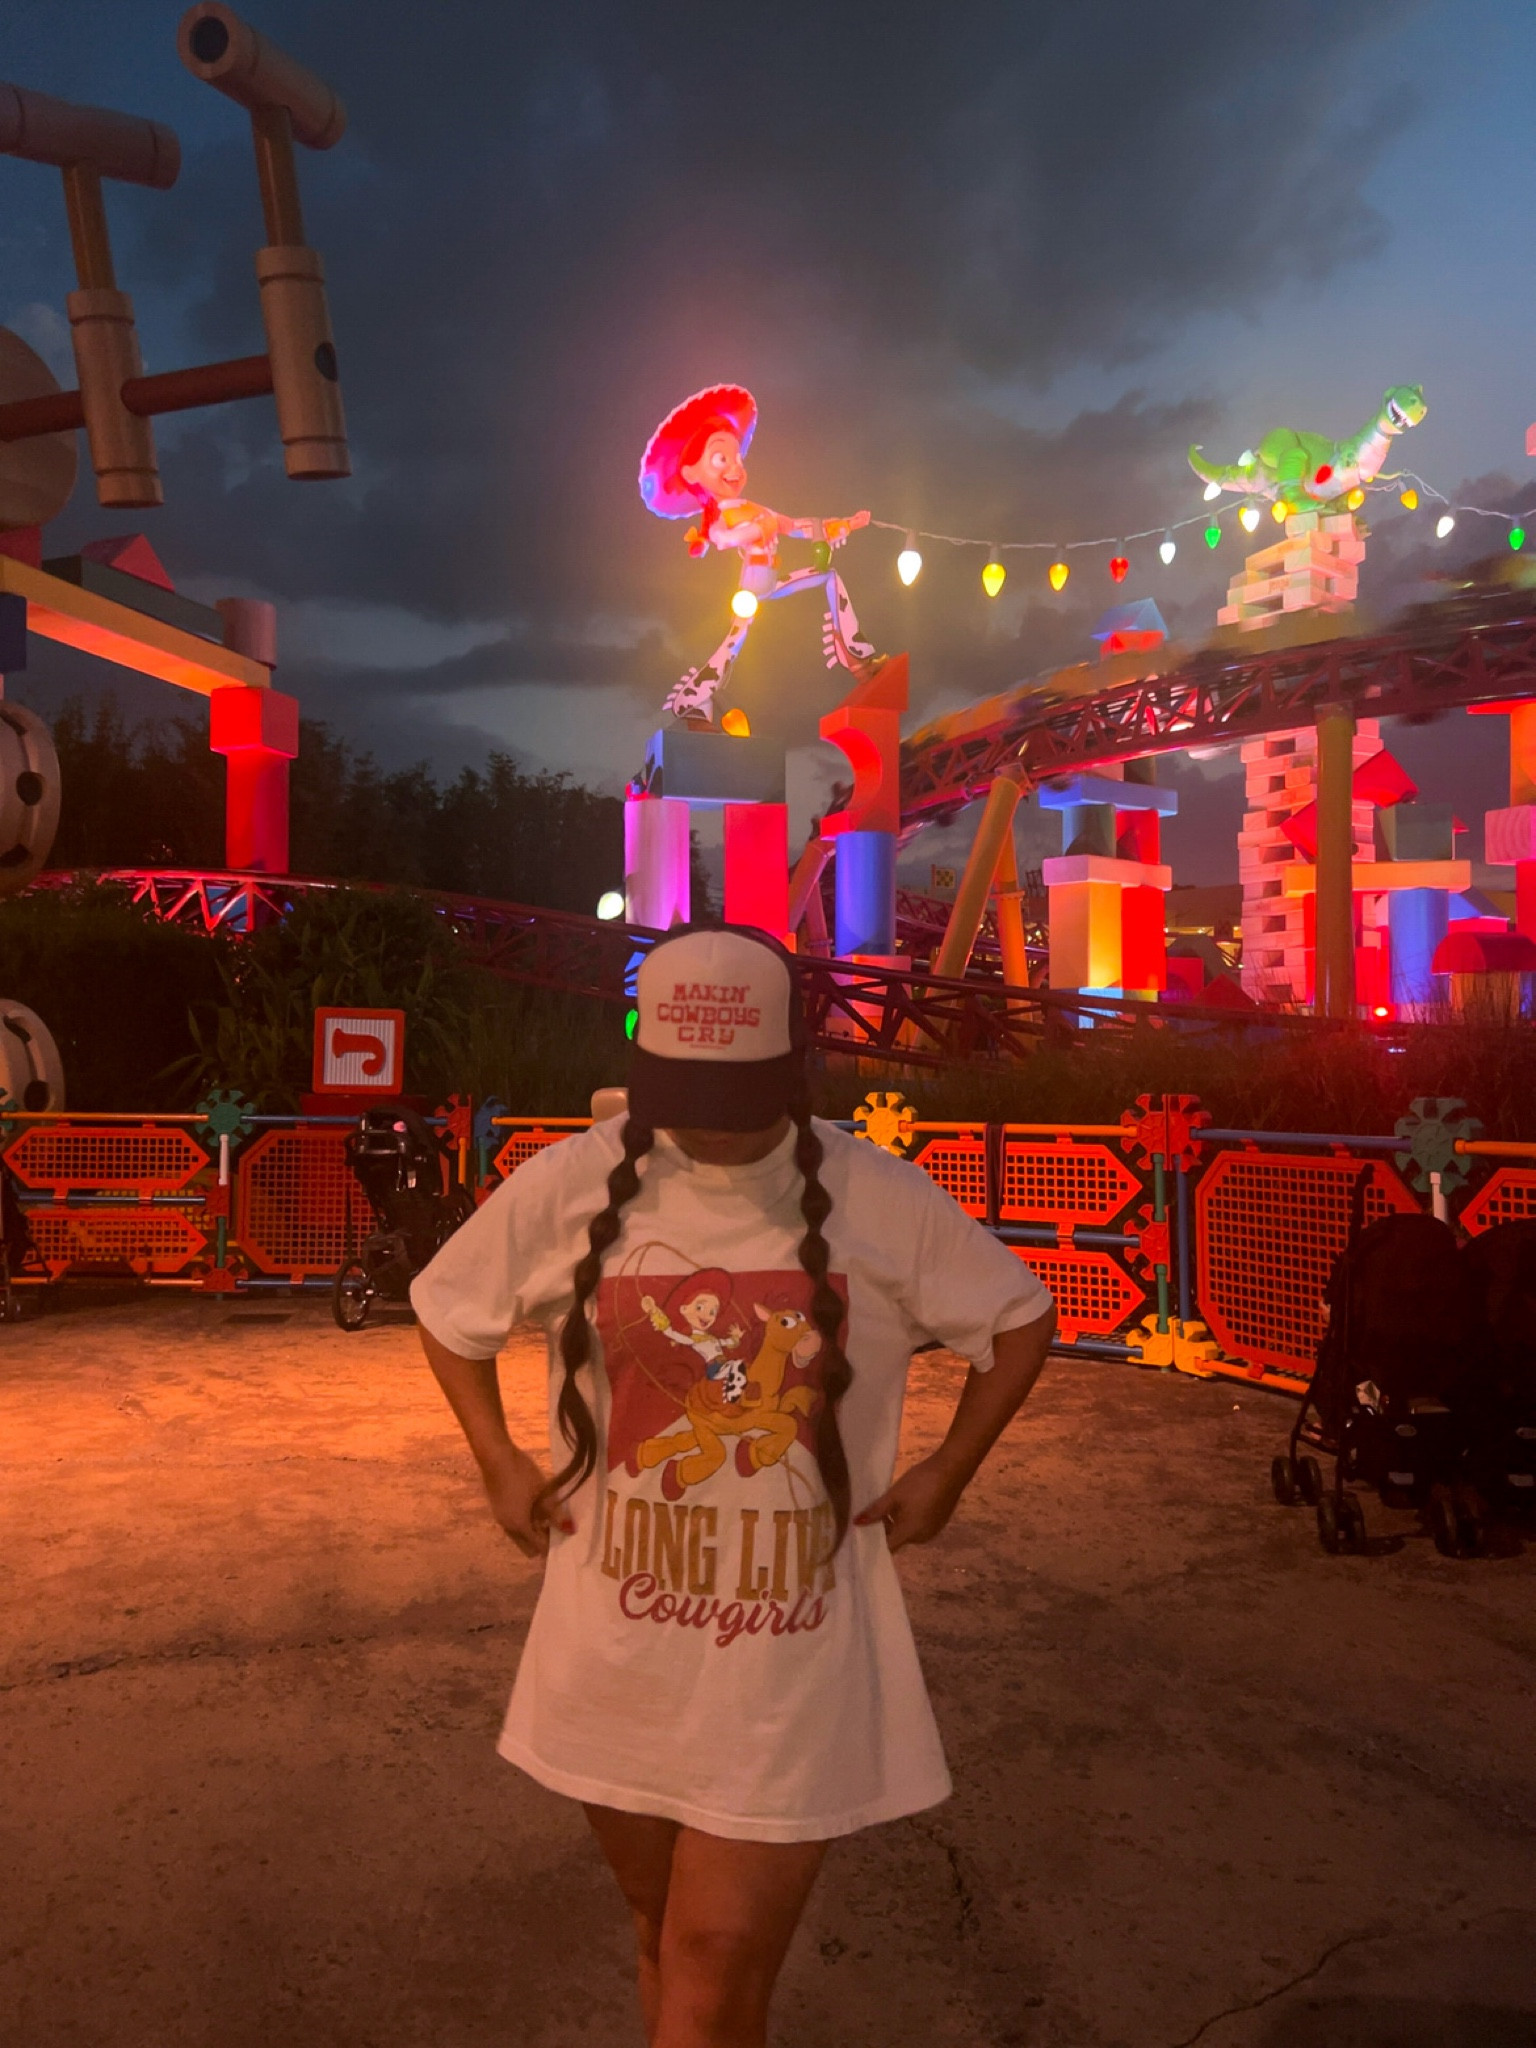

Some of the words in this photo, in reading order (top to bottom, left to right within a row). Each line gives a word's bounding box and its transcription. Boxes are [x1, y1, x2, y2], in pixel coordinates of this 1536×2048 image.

[657, 1003, 761, 1028] COWBOYS
[677, 1026, 735, 1045] CRY
[601, 1489, 718, 1595] LONG
[619, 1572, 828, 1648] Cowgirls
